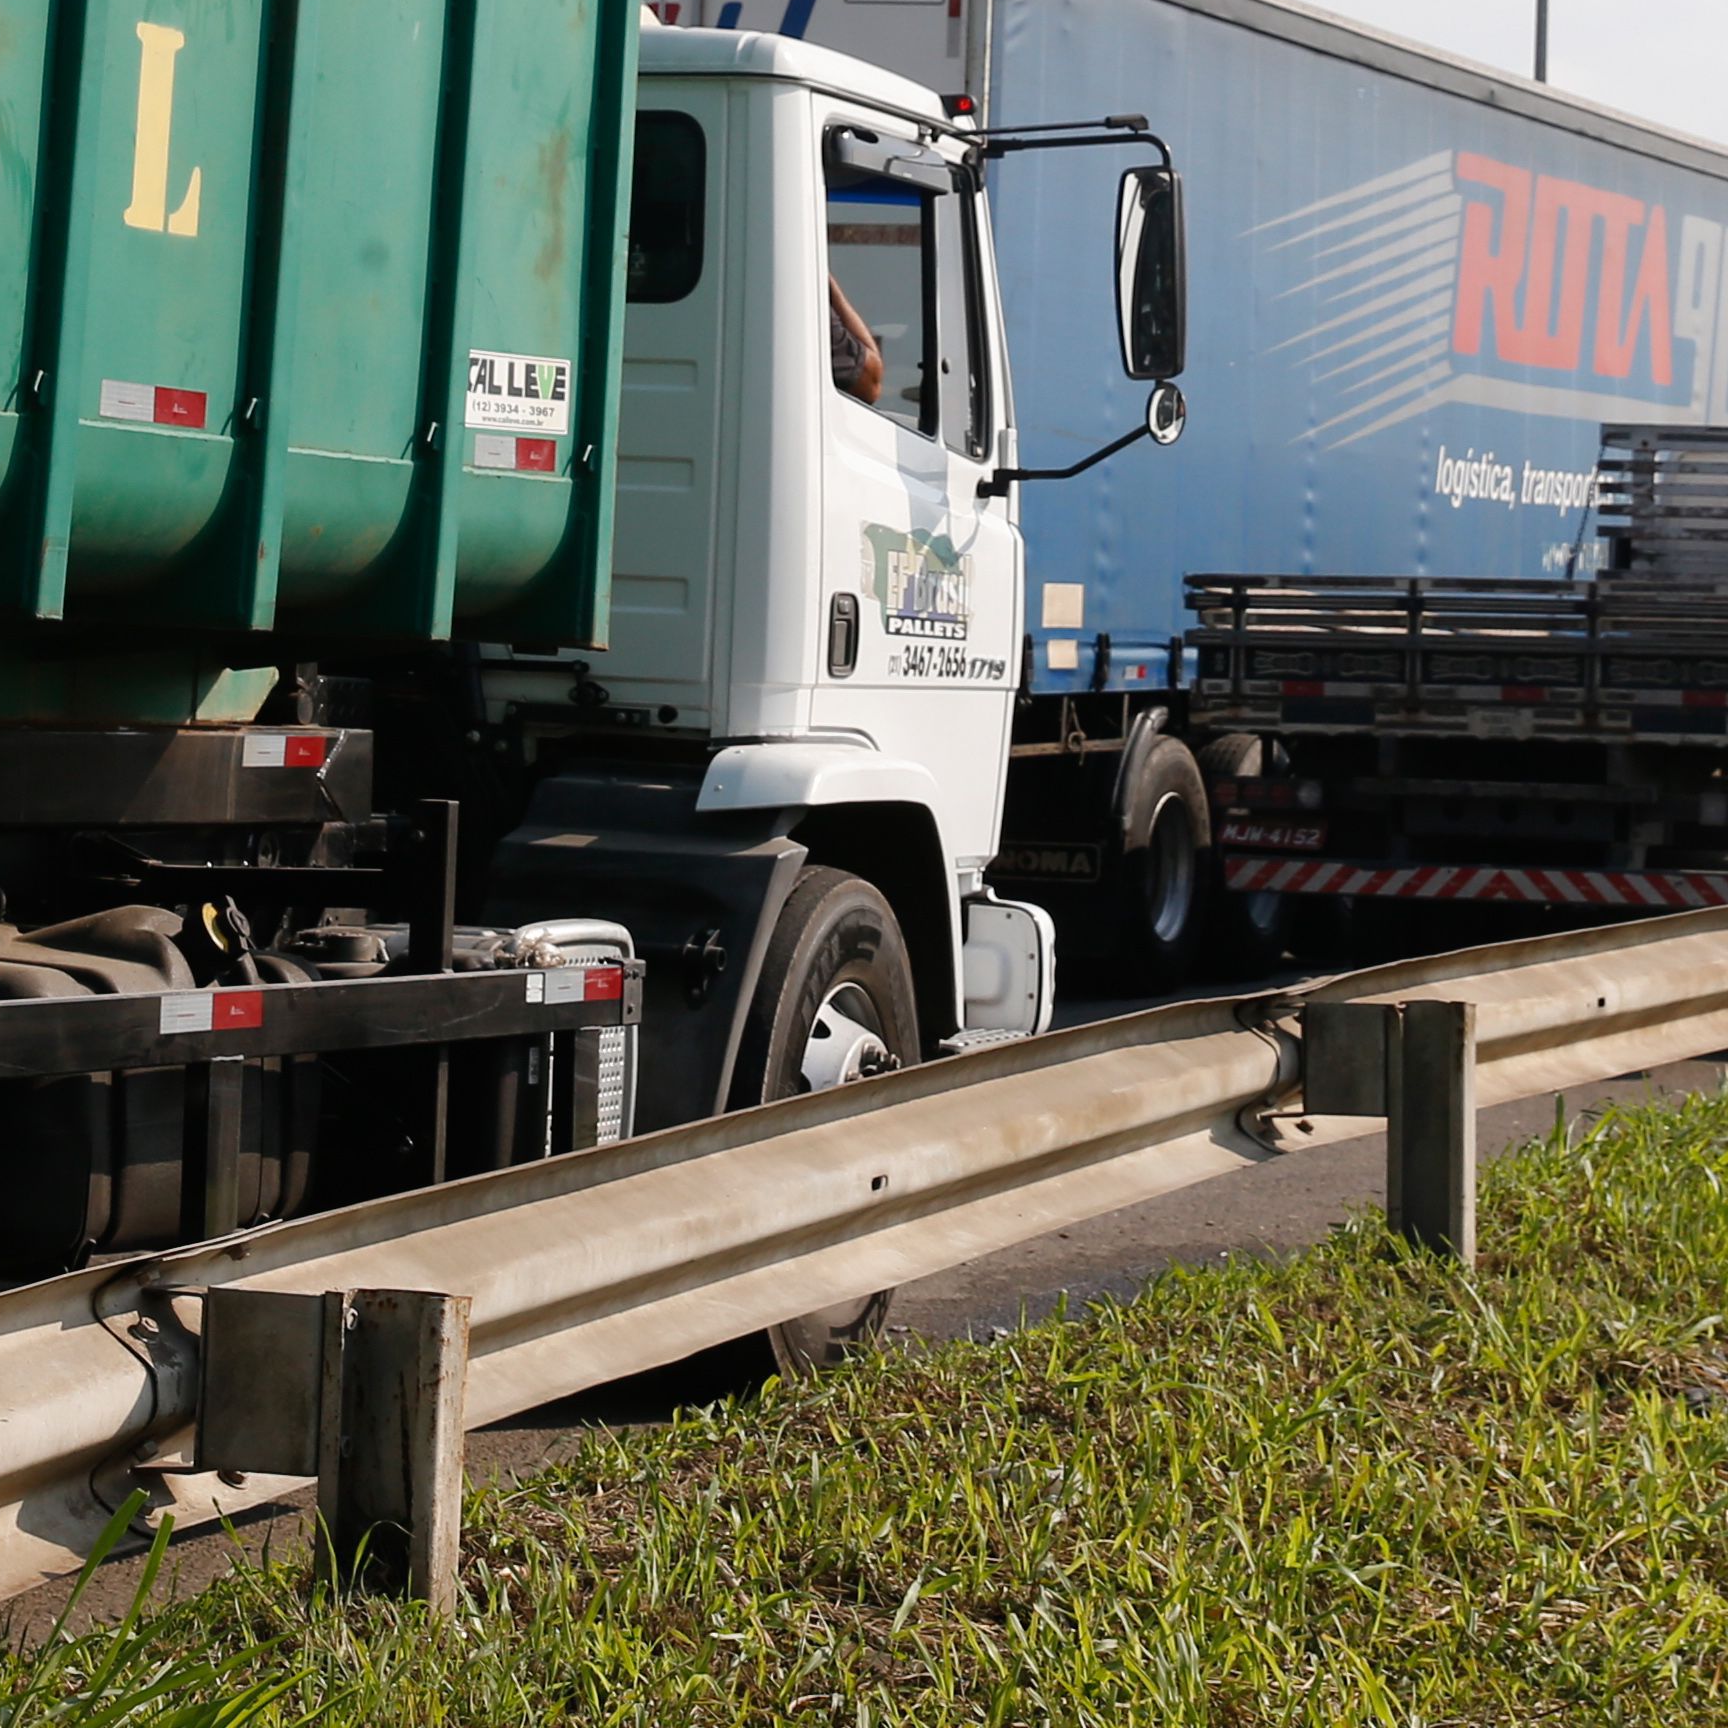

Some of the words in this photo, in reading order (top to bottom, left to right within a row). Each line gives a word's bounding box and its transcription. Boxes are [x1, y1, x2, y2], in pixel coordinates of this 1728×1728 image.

[468, 357, 502, 394] CAL
[508, 362, 566, 401] LEVE
[472, 399, 491, 413] (12)
[494, 402, 520, 415] 3934
[528, 405, 555, 418] 3967
[1434, 444, 1516, 510] logística,
[888, 618, 966, 639] PALLETS
[903, 644, 967, 678] 3467-2656
[992, 849, 1092, 873] NOMA
